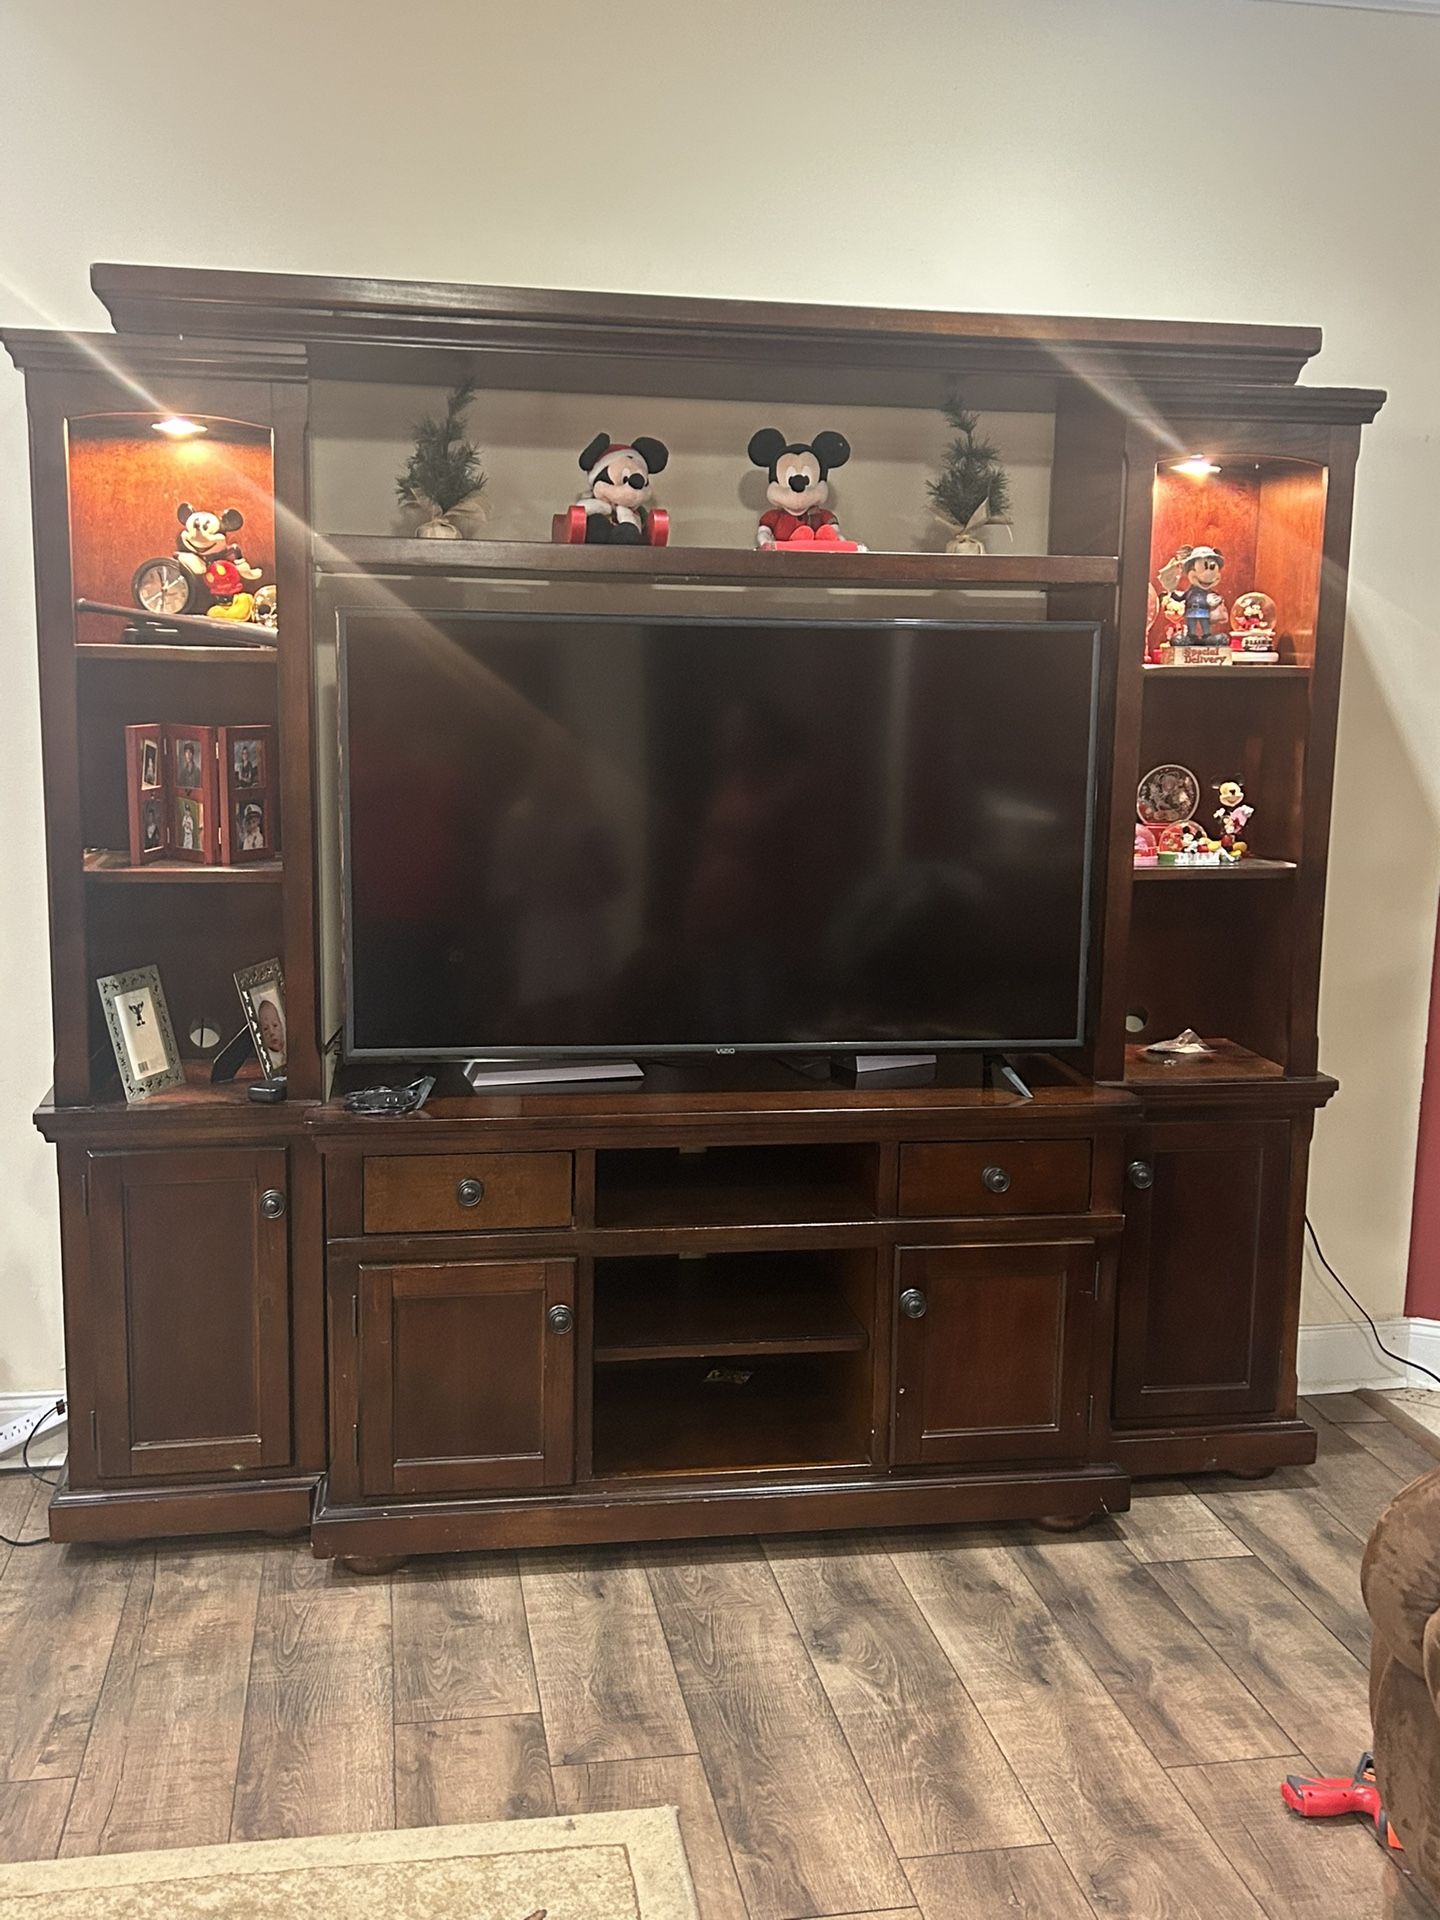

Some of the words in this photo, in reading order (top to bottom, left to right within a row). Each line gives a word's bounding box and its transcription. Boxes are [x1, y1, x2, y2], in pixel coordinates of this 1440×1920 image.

[1184, 647, 1219, 656] Special
[1184, 655, 1227, 666] Delivery
[716, 1047, 736, 1055] VIZIO
